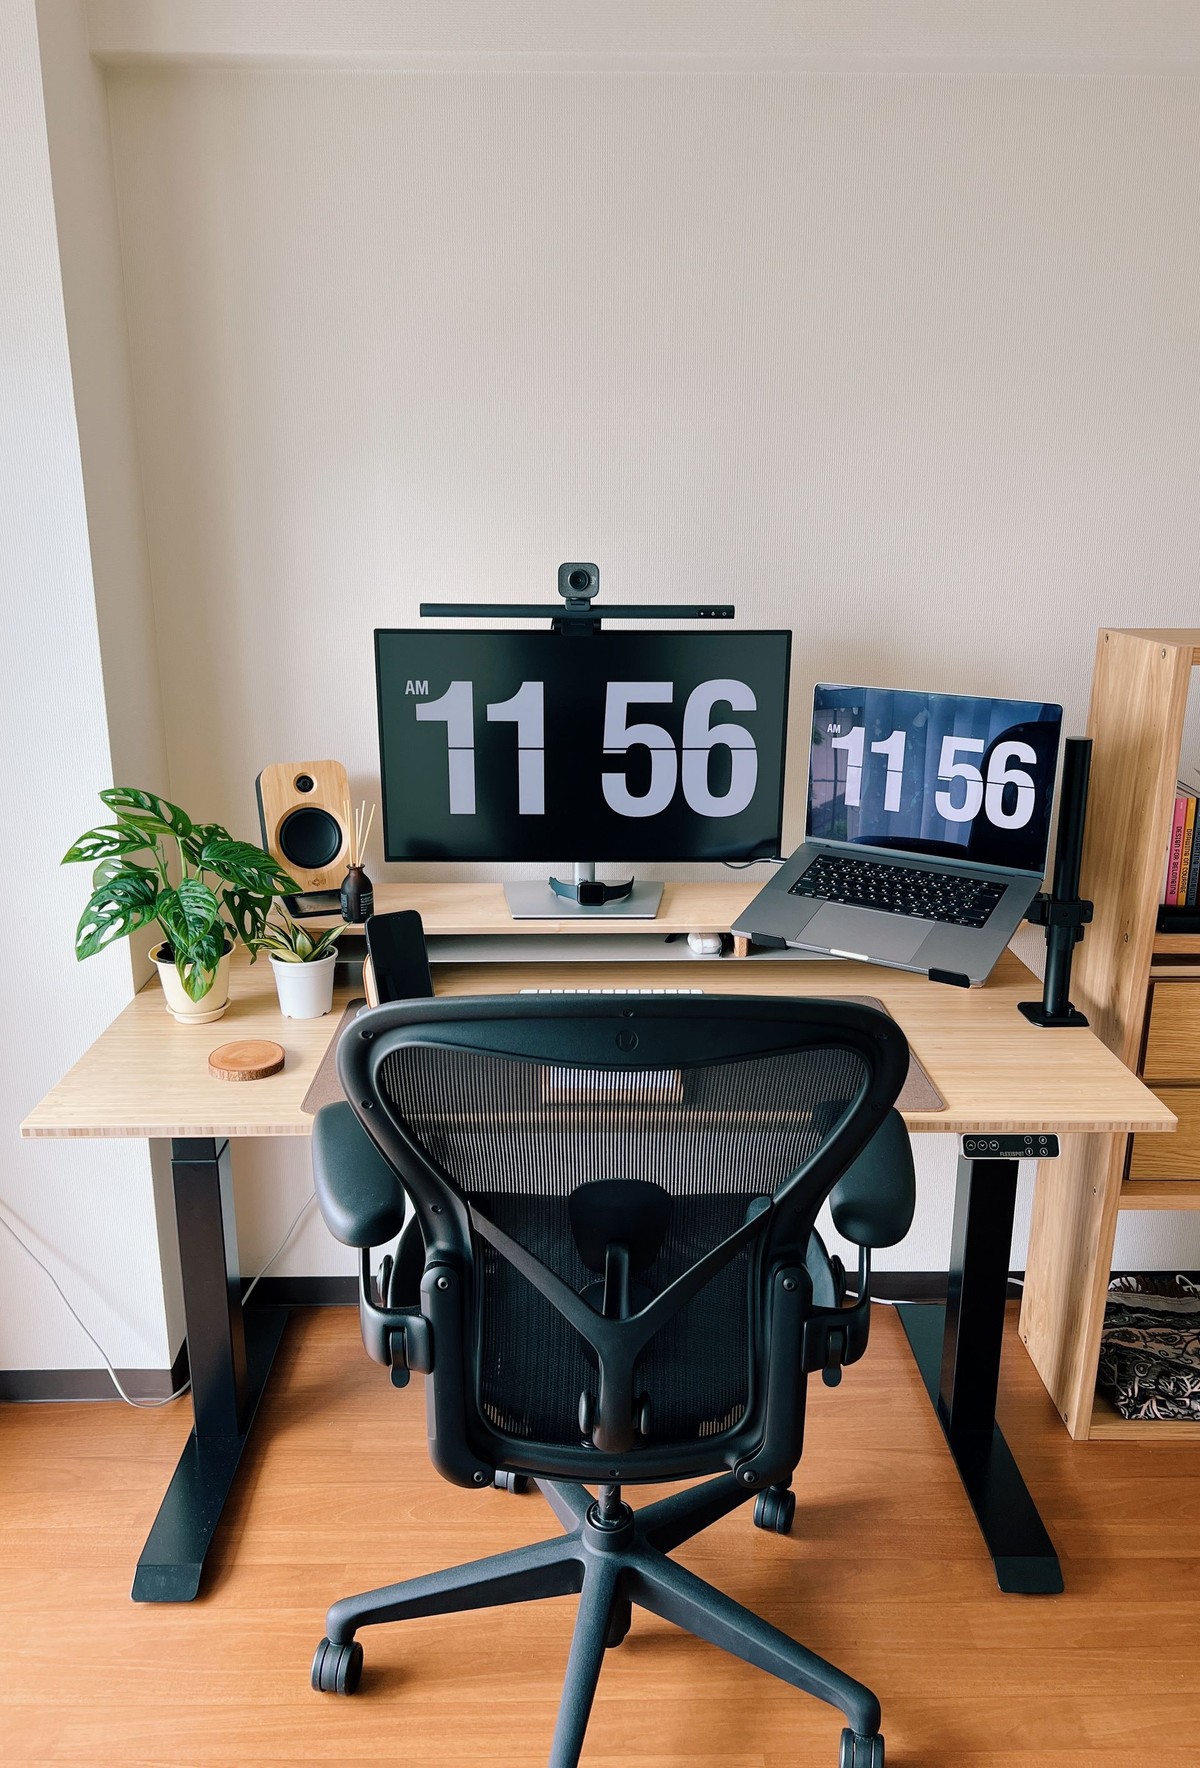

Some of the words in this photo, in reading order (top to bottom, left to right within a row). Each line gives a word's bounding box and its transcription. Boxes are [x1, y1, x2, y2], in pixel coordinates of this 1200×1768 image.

[405, 680, 429, 695] AM
[415, 680, 545, 815] 11
[601, 678, 758, 818] 56
[826, 723, 841, 734] AM
[831, 726, 906, 813] 11
[934, 735, 1037, 830] 56
